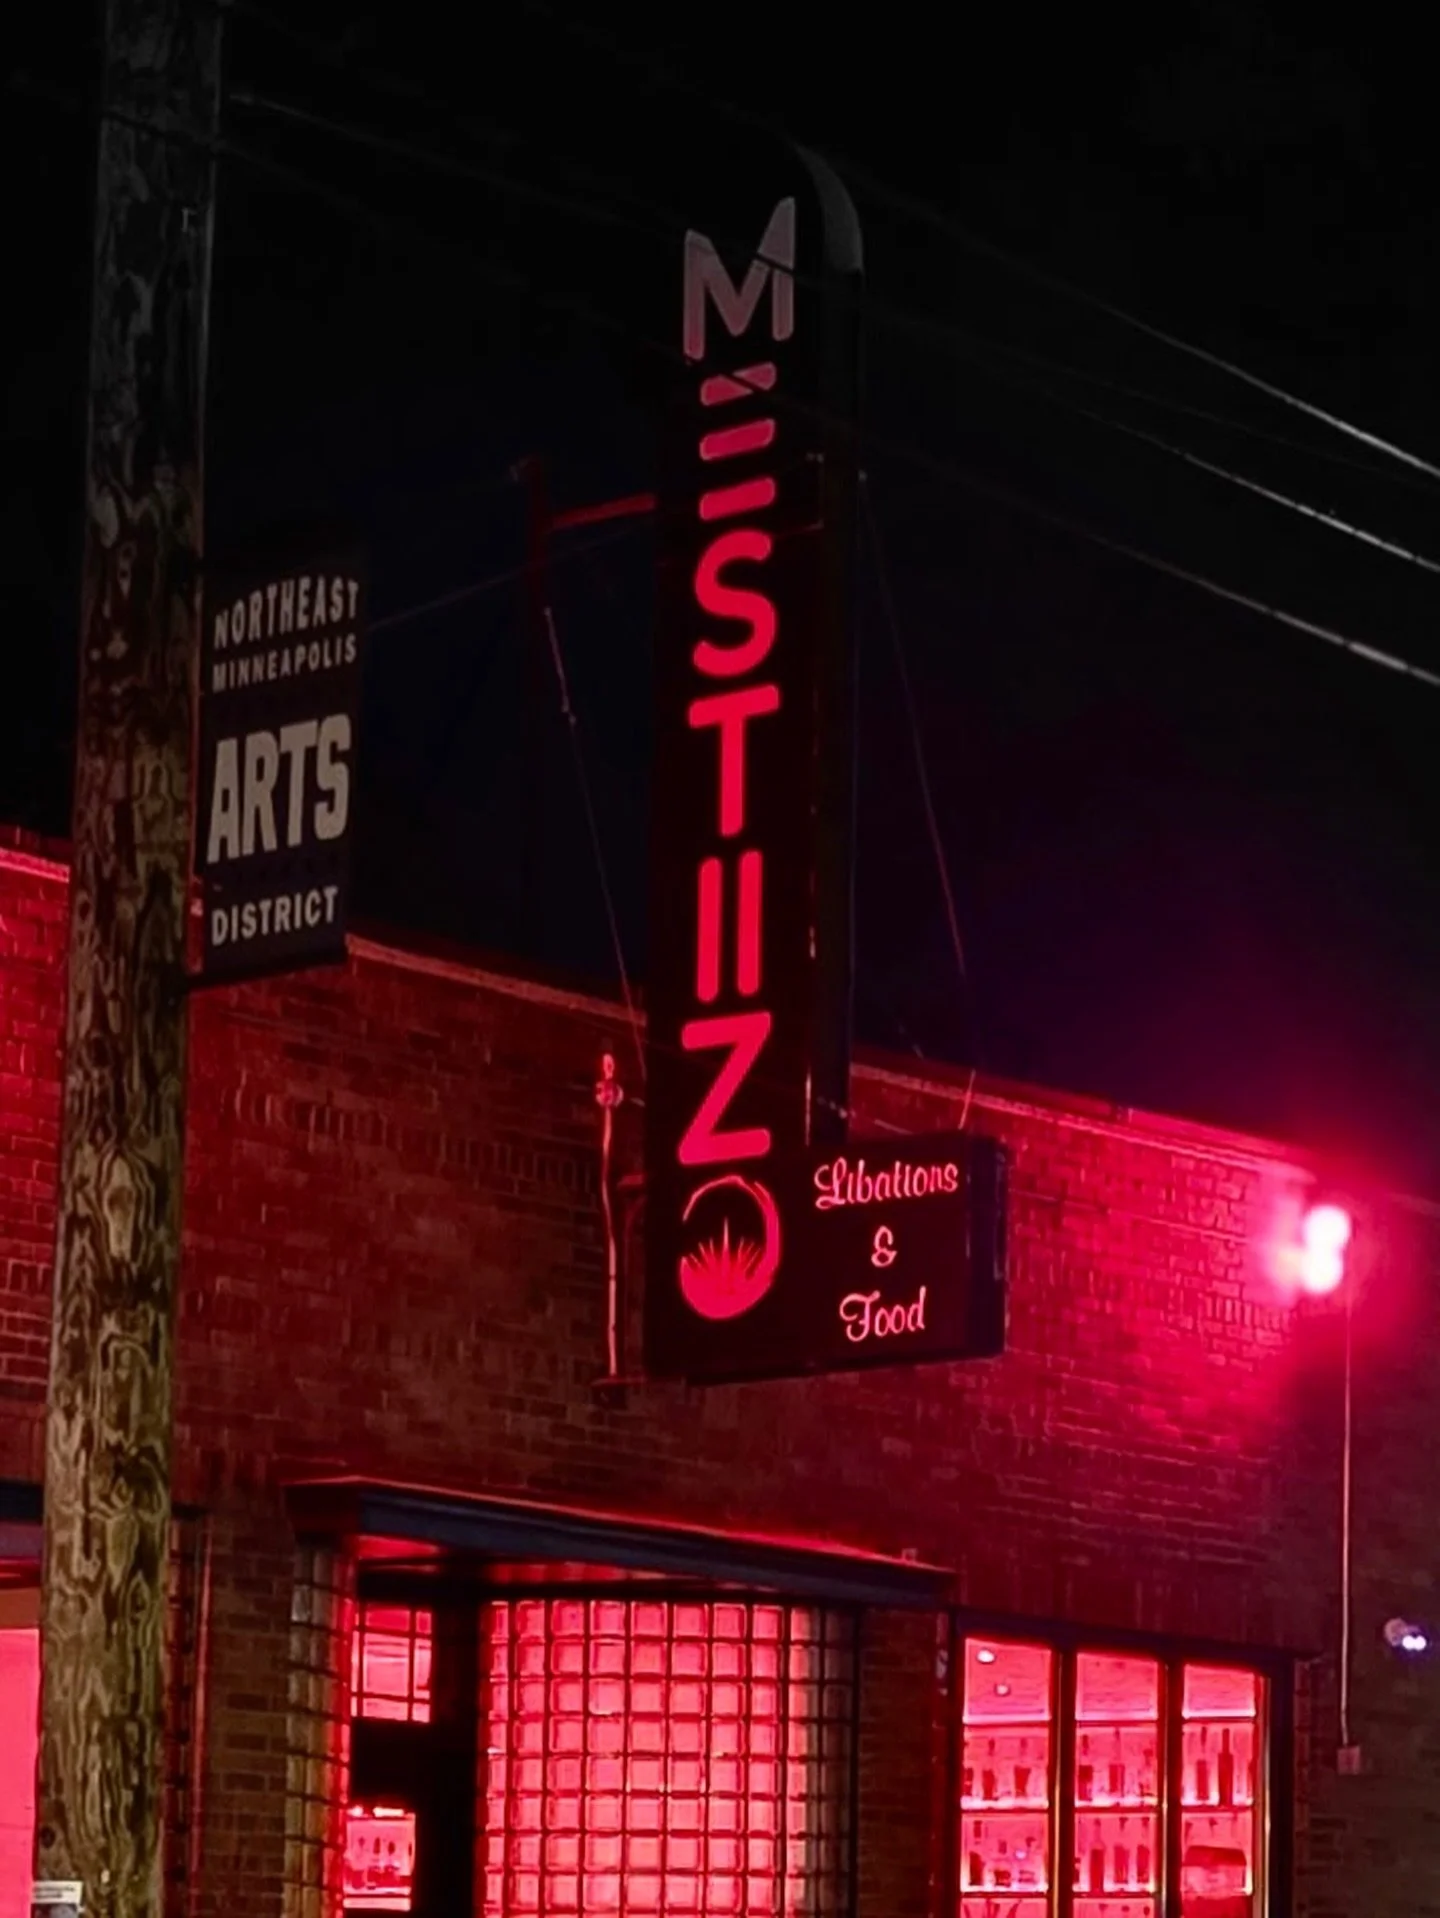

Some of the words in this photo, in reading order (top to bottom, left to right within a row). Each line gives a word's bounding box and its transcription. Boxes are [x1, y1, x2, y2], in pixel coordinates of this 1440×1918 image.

[213, 575, 359, 650] NORTHEAST
[211, 633, 358, 693] MINNEAPOLIS
[207, 713, 351, 864] ARTS
[211, 885, 339, 947] DISTRICT
[814, 1157, 958, 1209] Libations
[871, 1226, 897, 1267] &
[839, 1285, 926, 1341] Food
